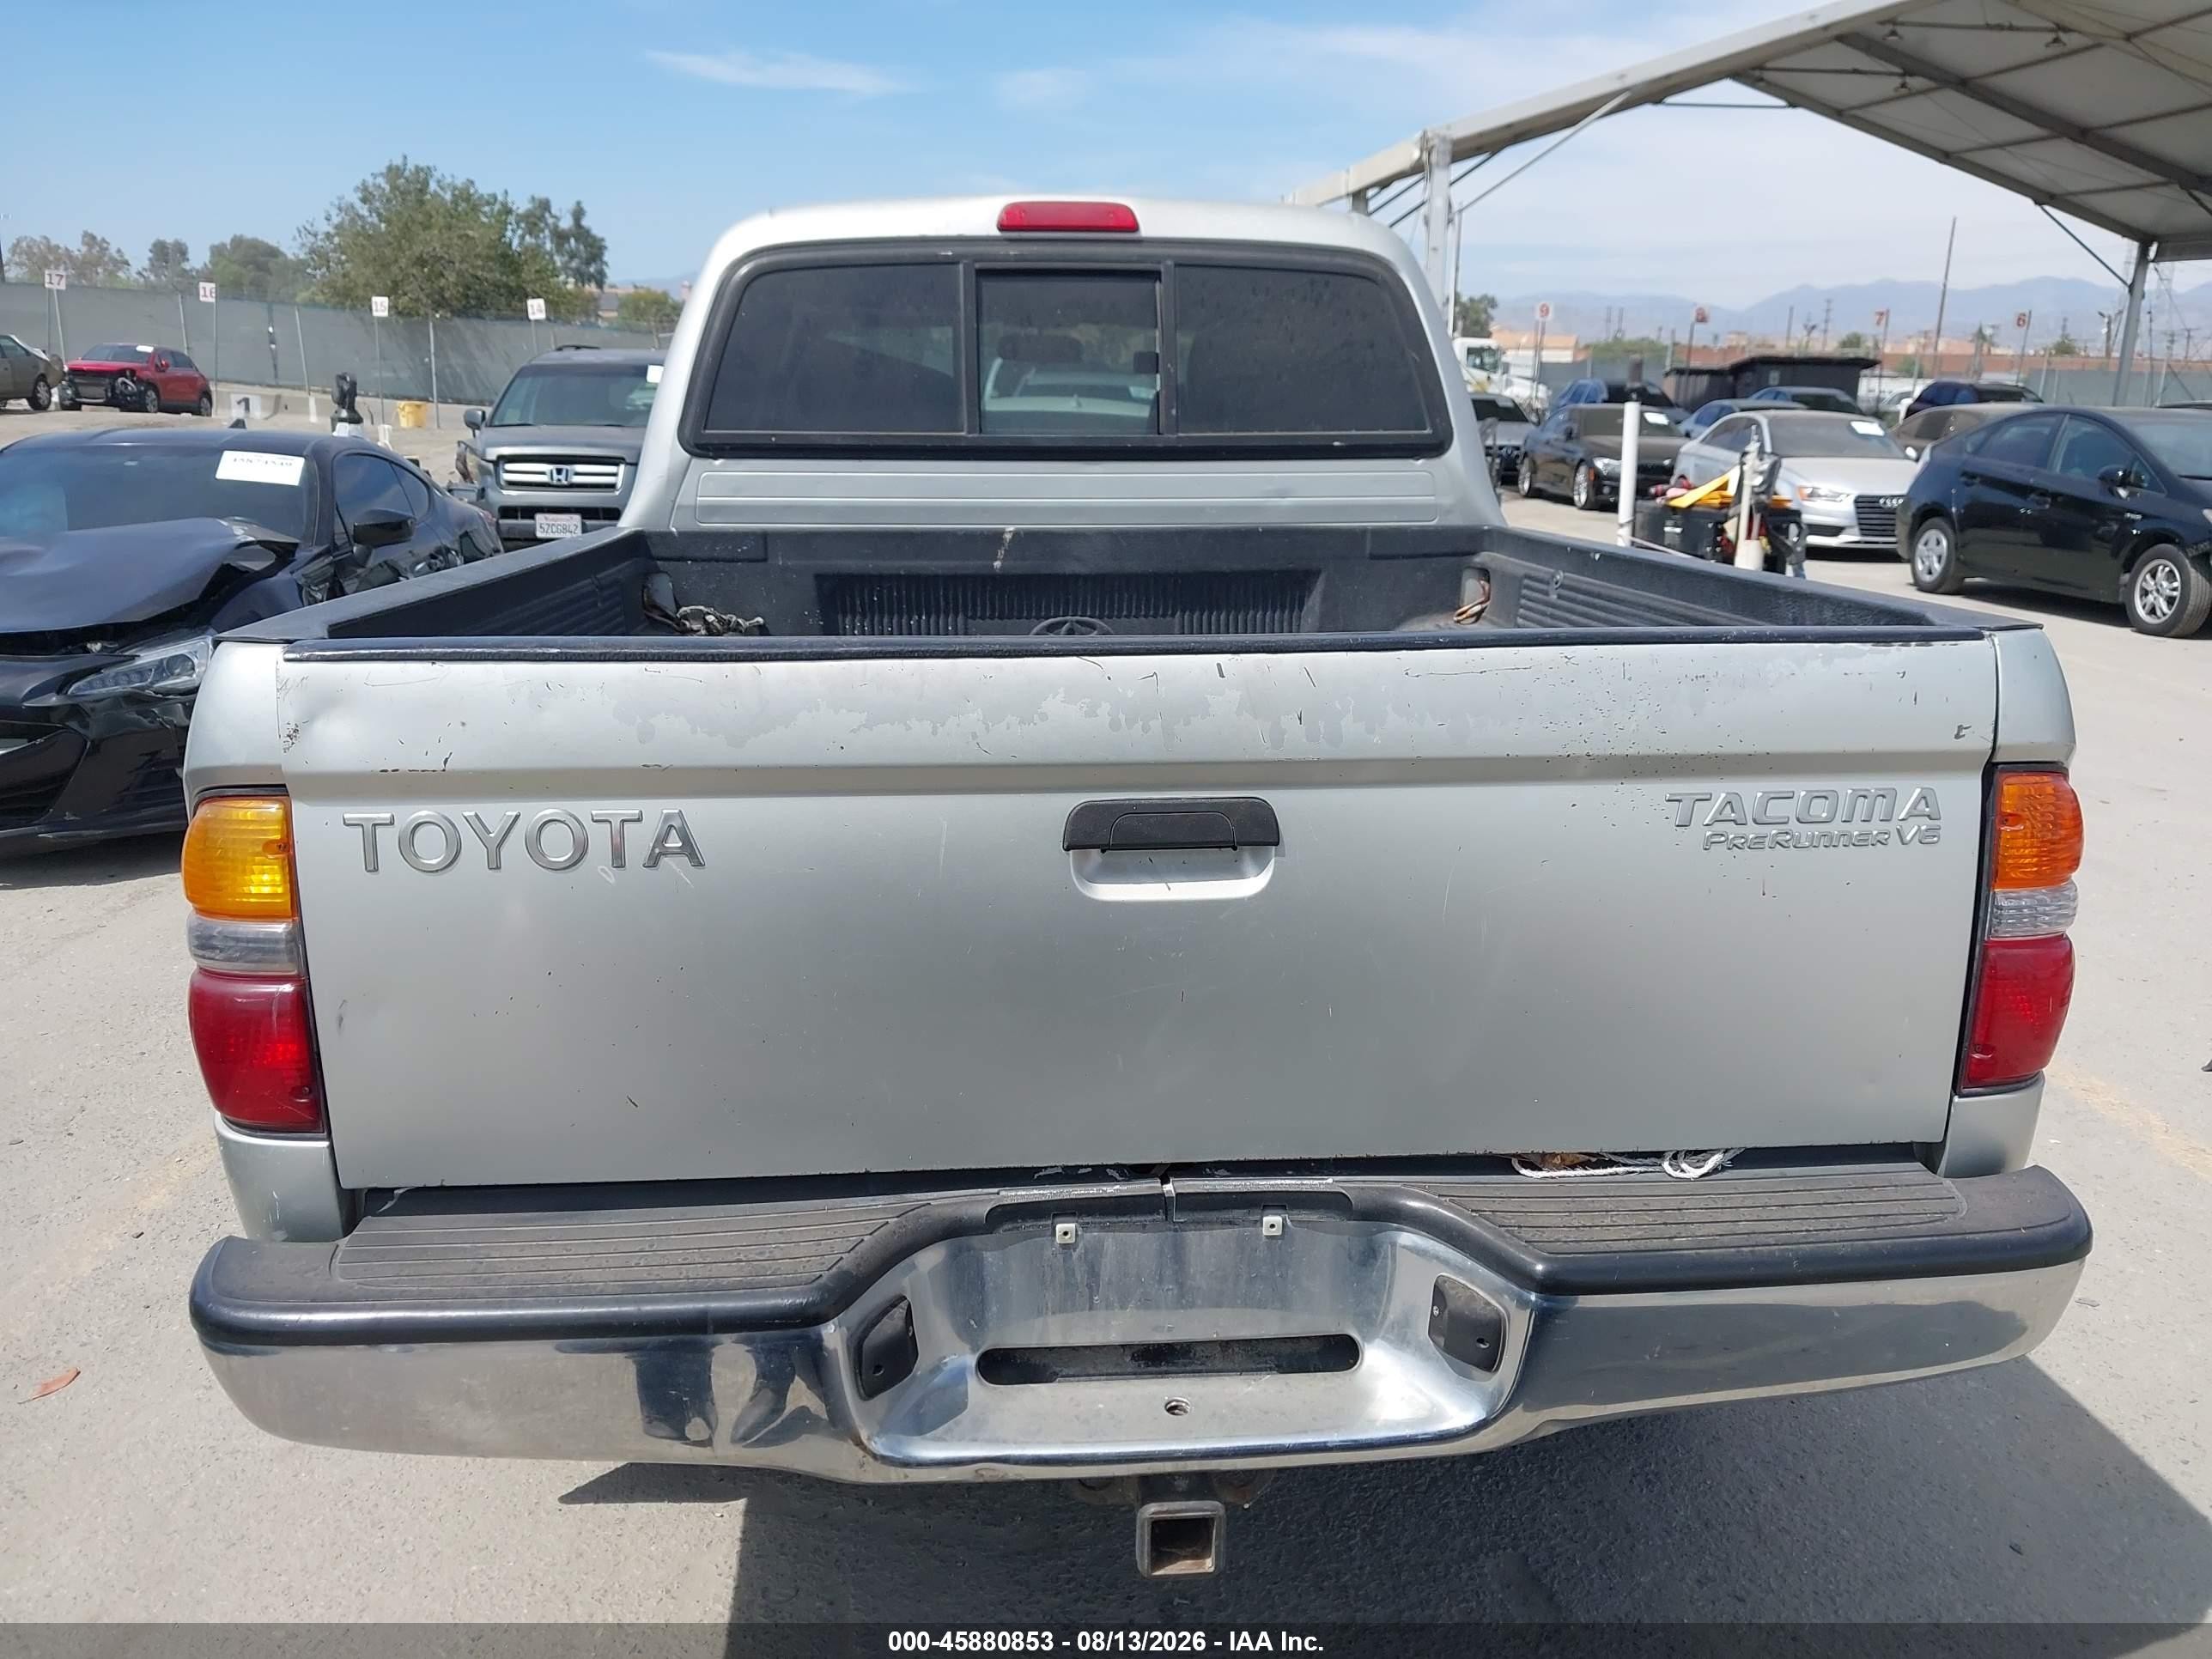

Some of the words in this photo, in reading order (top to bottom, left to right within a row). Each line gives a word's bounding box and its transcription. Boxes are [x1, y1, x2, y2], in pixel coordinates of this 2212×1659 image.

[46, 272, 64, 287] 17
[374, 301, 387, 313] 15
[1875, 311, 1885, 326] 7
[2016, 313, 2027, 328] 6
[1665, 787, 1942, 827] TACOMA
[342, 808, 706, 873] TOYOTA
[1896, 824, 1942, 846] V6
